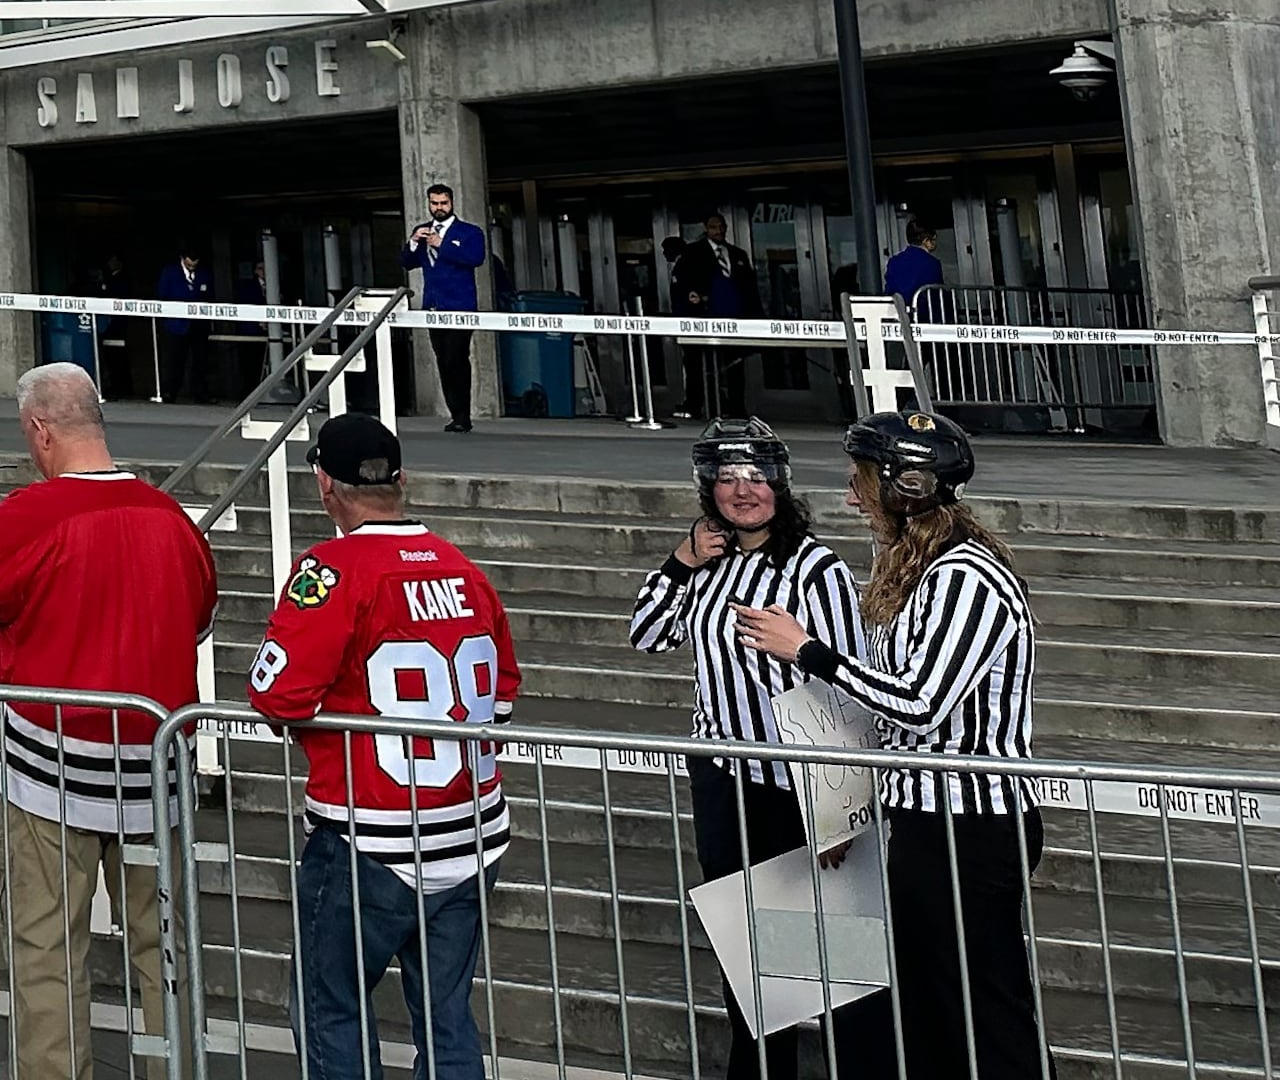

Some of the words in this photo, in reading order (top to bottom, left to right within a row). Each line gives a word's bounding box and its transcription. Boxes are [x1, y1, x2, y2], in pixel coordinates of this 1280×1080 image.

[37, 67, 139, 128] SAN
[174, 40, 340, 113] JOSE
[39, 297, 48, 308] DO
[50, 298, 62, 309] NOT
[65, 299, 86, 310] ENTER
[113, 301, 122, 311] DO
[125, 302, 138, 313] NOT
[140, 303, 162, 313] ENTER
[188, 305, 197, 315] DO
[199, 305, 212, 316] NOT
[215, 306, 238, 317] ENTER
[266, 308, 276, 318] DO
[278, 308, 291, 319] NOT
[293, 309, 317, 320] ENTER
[344, 311, 354, 321] DO
[426, 313, 436, 324] DO
[438, 314, 453, 325] NOT
[455, 315, 480, 326] ENTER
[508, 316, 518, 327] DO
[521, 317, 535, 328] NOT
[538, 318, 563, 329] ENTER
[594, 318, 604, 329] DO
[607, 319, 622, 330] NOT
[625, 320, 650, 331] ENTER
[680, 321, 691, 332] DO
[694, 322, 709, 333] NOT
[711, 322, 738, 334] ENTER
[771, 323, 781, 334] DO
[784, 324, 800, 335] NOT
[803, 324, 830, 336] ENTER
[957, 327, 968, 338] DO
[971, 327, 988, 339] NOT
[991, 328, 1019, 340] ENTER
[1053, 329, 1064, 340] DO
[1067, 330, 1085, 341] NOT
[1088, 331, 1116, 342] ENTER
[1154, 332, 1167, 342] DO
[1170, 333, 1186, 342] NOT
[1190, 333, 1219, 343] ENTER
[399, 549, 439, 563] Reebok
[403, 577, 474, 622] KANE
[366, 633, 498, 789] 88
[1041, 778, 1071, 803] TER
[1138, 786, 1160, 809] DO
[1165, 789, 1199, 813] NOT
[1206, 793, 1261, 819] ENTER
